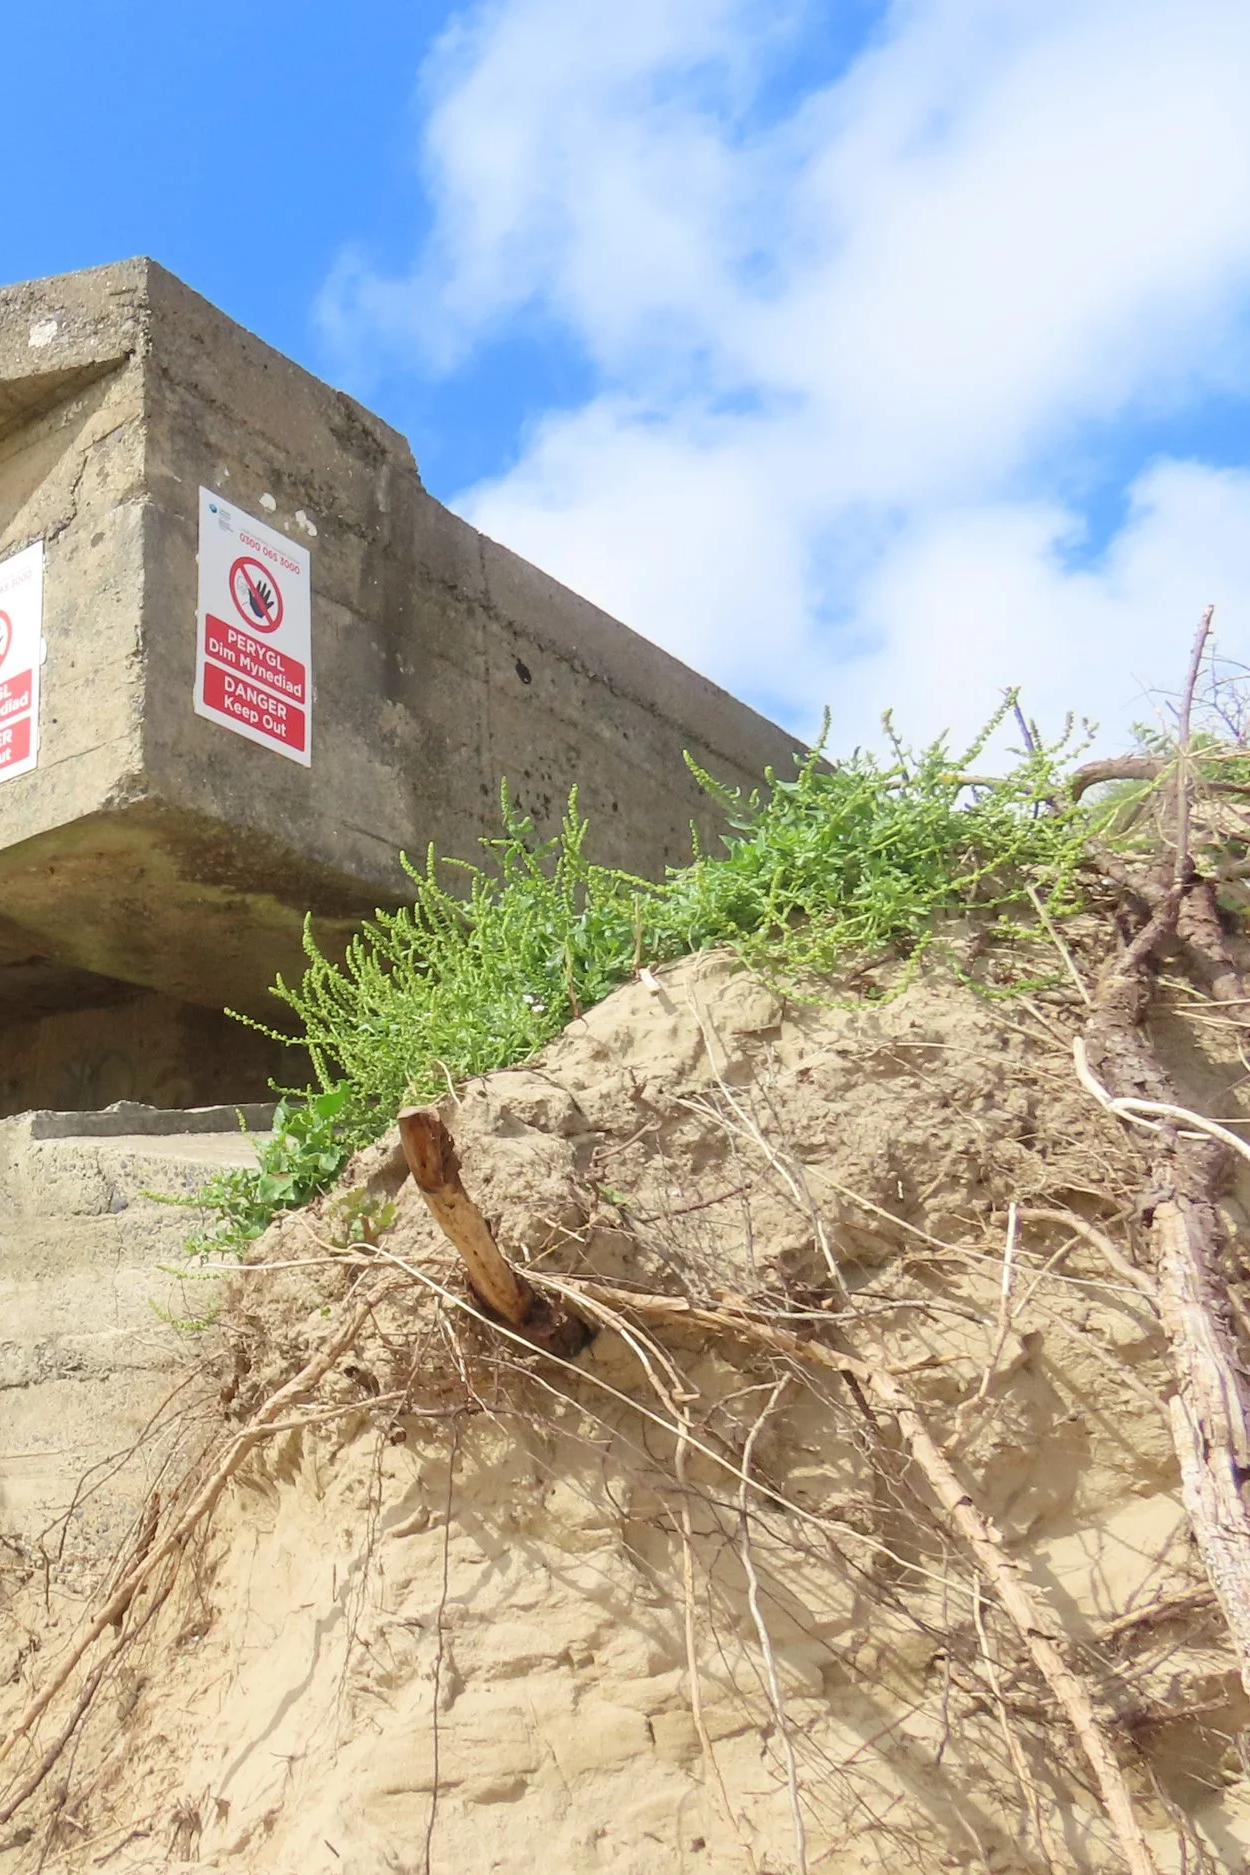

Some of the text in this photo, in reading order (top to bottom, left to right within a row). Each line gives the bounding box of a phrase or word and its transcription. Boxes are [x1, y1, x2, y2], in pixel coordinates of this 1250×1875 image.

[239, 533, 261, 551] 0300
[262, 546, 278, 562] 065
[279, 556, 301, 574] 3000
[209, 637, 302, 697] Dim Mynediad
[228, 629, 285, 671] PERYGL
[224, 676, 287, 720] DANGER
[224, 695, 287, 737] Keep Out
